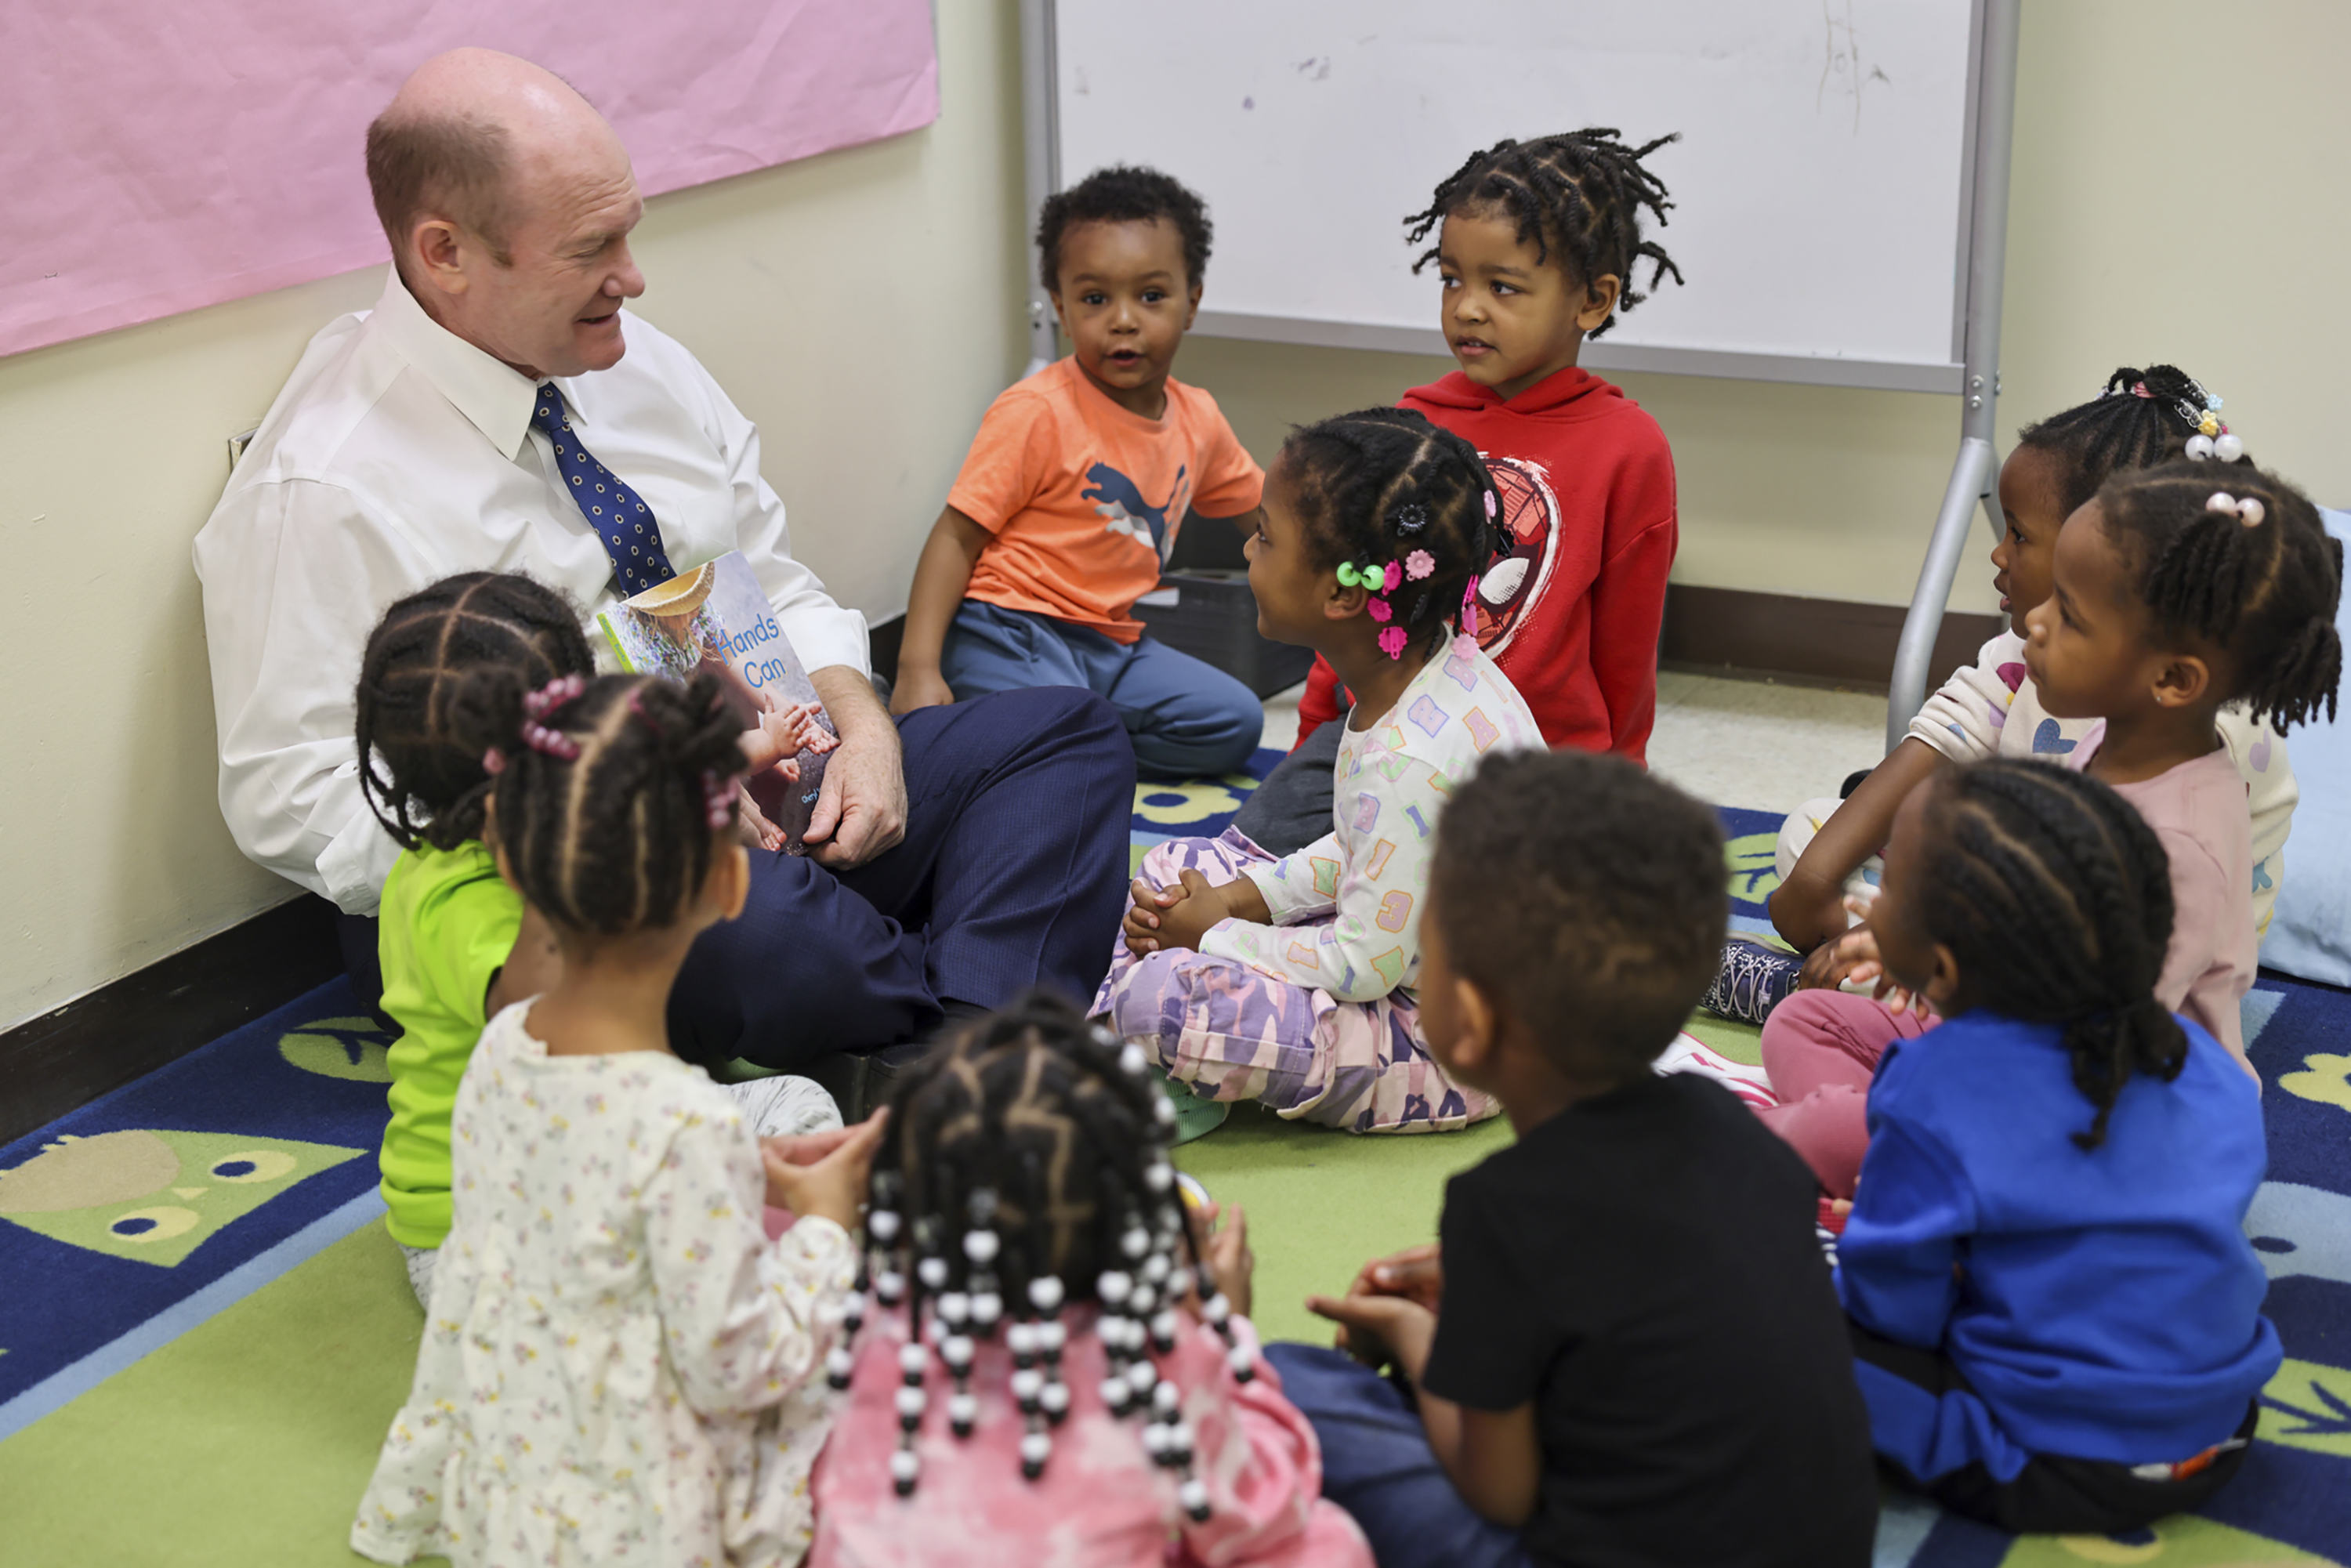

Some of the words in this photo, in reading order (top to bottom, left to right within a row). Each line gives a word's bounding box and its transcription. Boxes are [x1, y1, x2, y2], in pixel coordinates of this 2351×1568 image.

[712, 613, 780, 666] Hands
[744, 658, 787, 689] Can
[1375, 889, 1414, 934] 3
